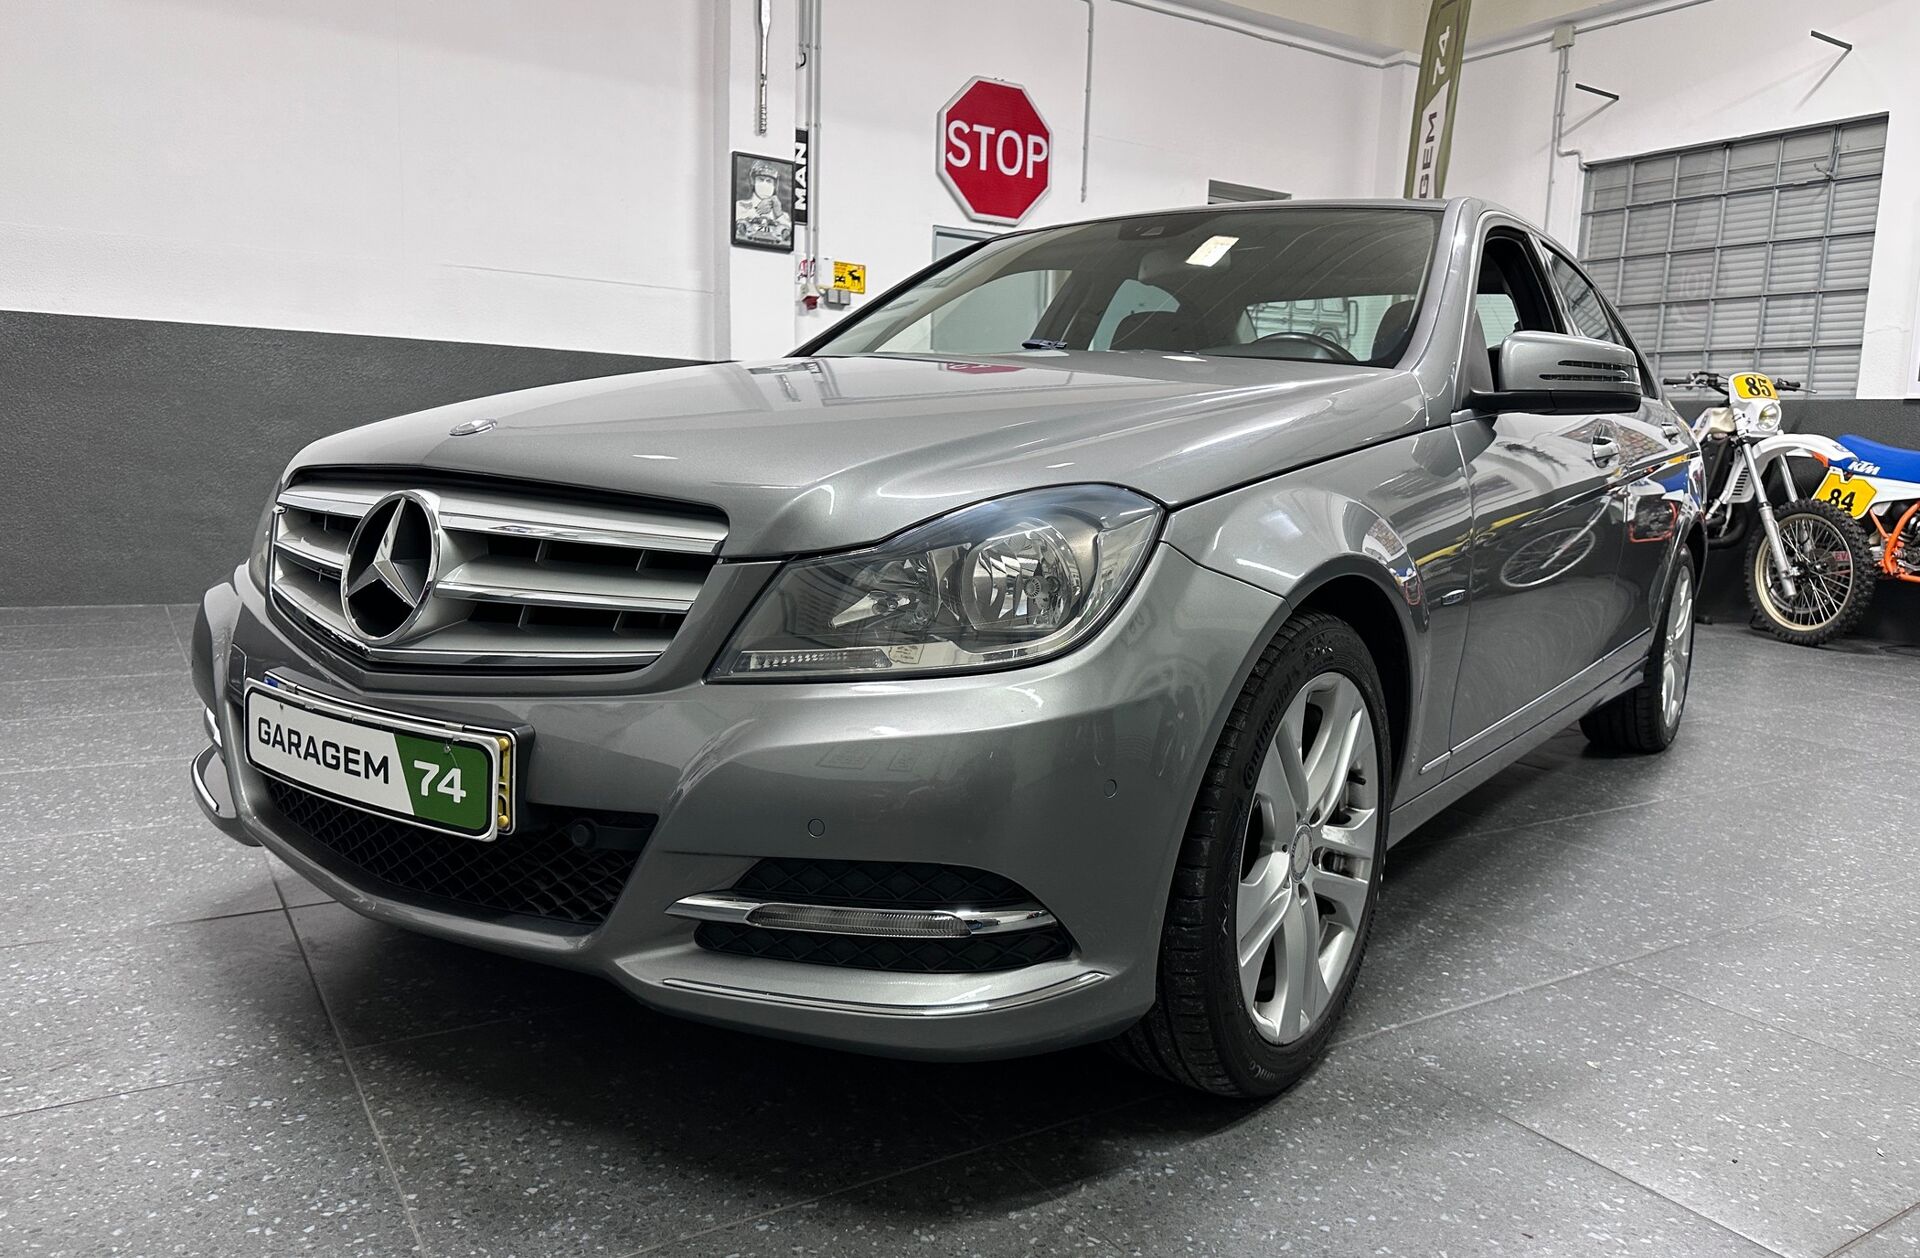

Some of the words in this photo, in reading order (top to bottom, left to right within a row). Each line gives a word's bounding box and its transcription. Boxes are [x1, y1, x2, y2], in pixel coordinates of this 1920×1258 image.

[1432, 25, 1450, 86] 74
[795, 142, 807, 211] MAN
[946, 120, 1048, 179] STOP
[1745, 377, 1771, 397] 85
[1848, 460, 1881, 475] KTM
[1829, 488, 1856, 512] 84
[257, 716, 390, 785] GARAGEM
[413, 759, 467, 804] 74
